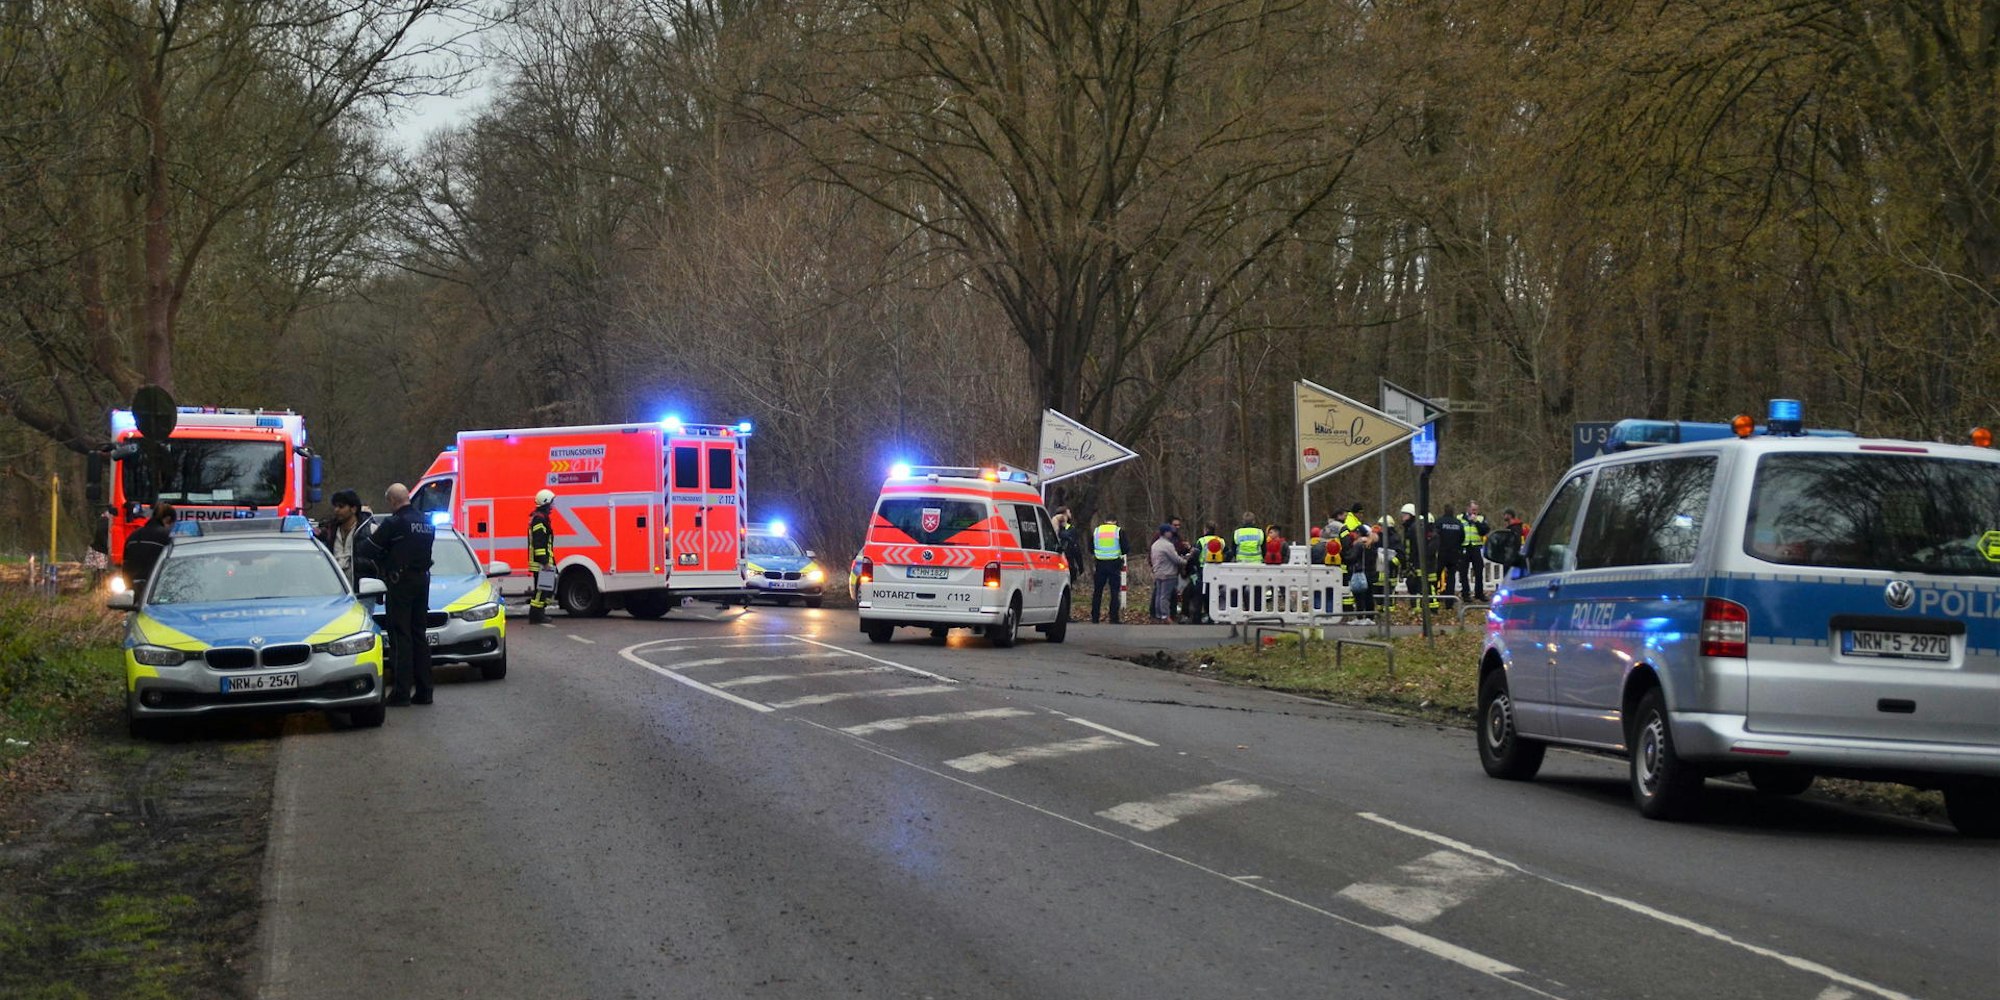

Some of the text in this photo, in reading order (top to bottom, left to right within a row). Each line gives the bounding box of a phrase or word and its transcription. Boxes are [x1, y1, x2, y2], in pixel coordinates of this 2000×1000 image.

[1343, 416, 1372, 447] See
[1580, 427, 1607, 444] U 3
[550, 447, 604, 457] RETTUNGSDIENST
[1075, 439, 1095, 461] See
[584, 459, 603, 471] 112
[725, 495, 735, 504] 112
[176, 510, 255, 521] UERWEHR
[872, 590, 915, 599] NOTARZT
[954, 593, 970, 602] 112
[201, 608, 306, 620] POLIZEI
[1570, 602, 1616, 630] POLIZEI
[1853, 632, 1947, 654] NRW 5-2970
[229, 677, 250, 690] NRW
